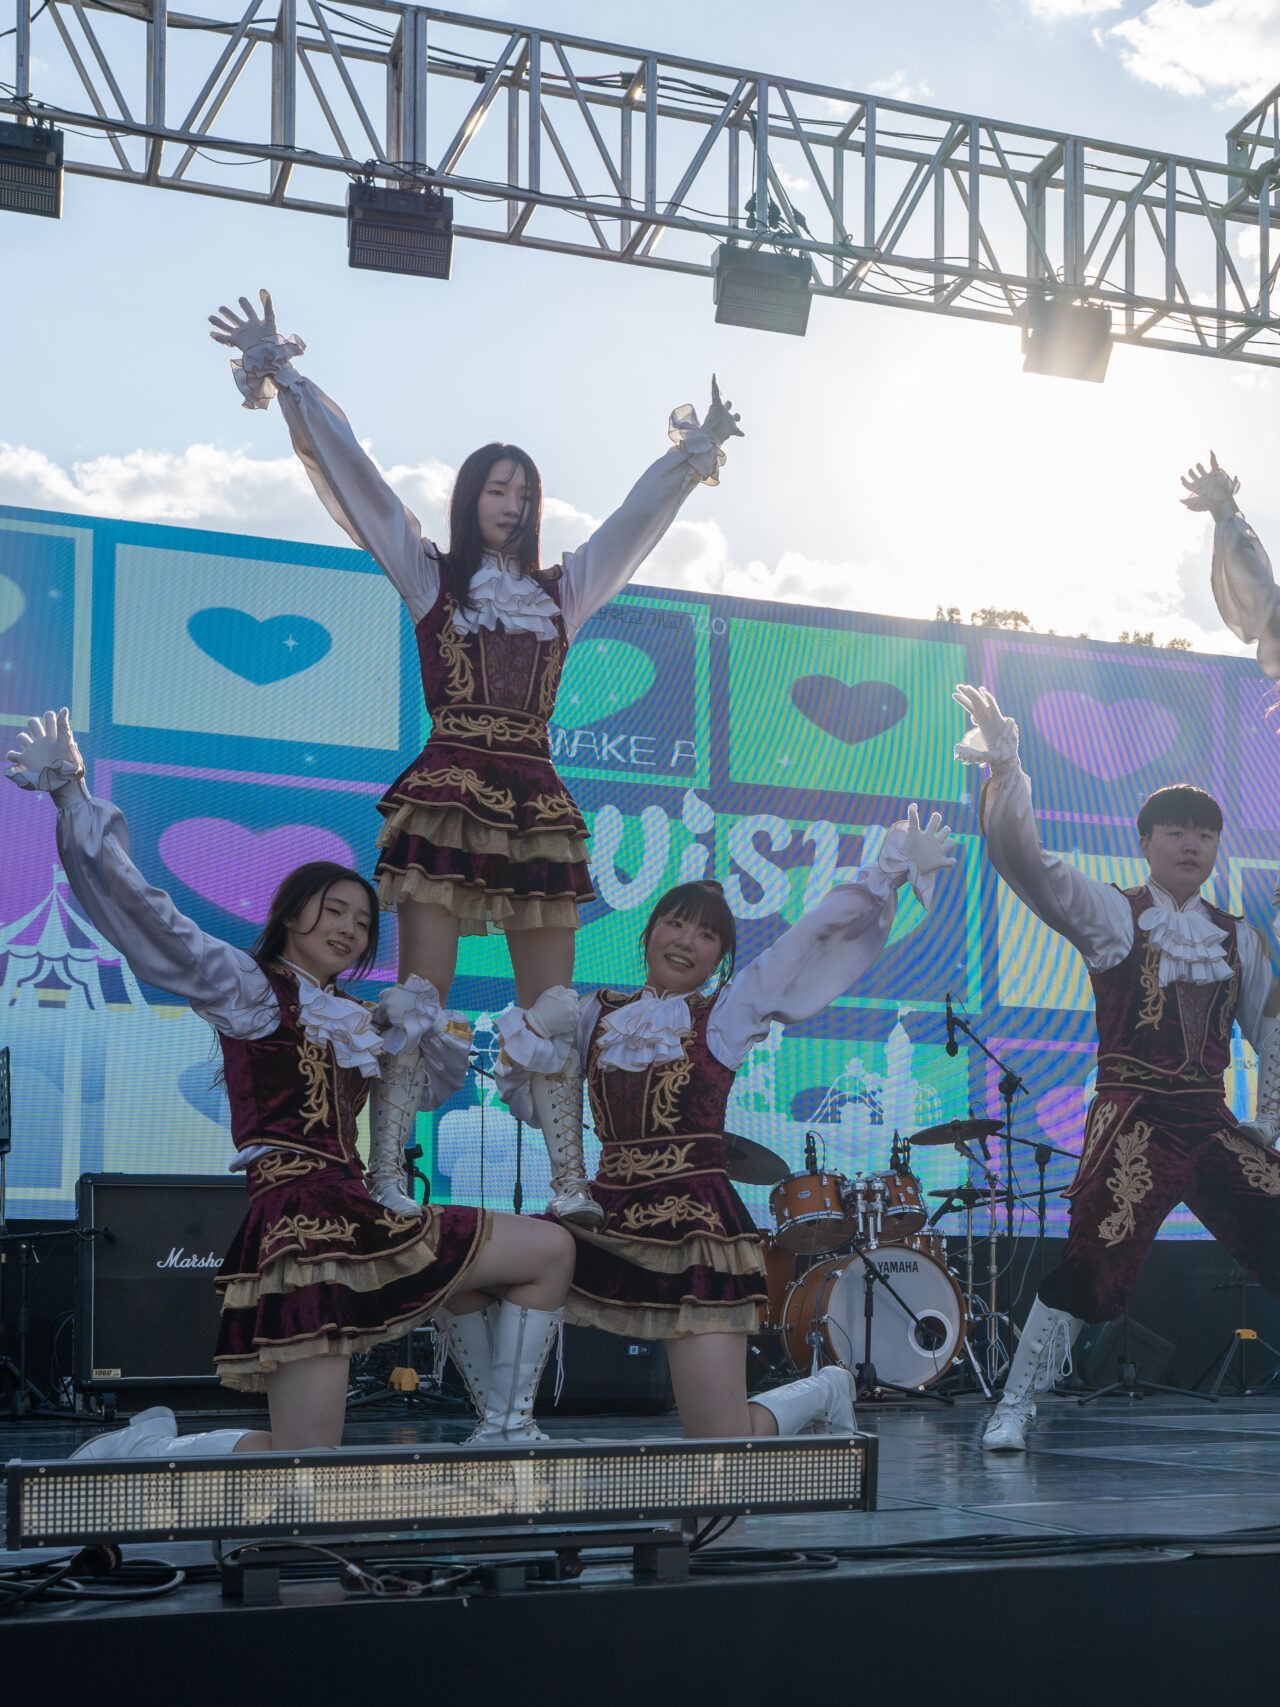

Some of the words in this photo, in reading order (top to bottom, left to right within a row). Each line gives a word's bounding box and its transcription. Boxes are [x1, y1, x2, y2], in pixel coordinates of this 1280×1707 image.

[670, 740, 700, 769] A
[156, 1248, 225, 1268] Marsha
[877, 1261, 919, 1273] YAMAHA
